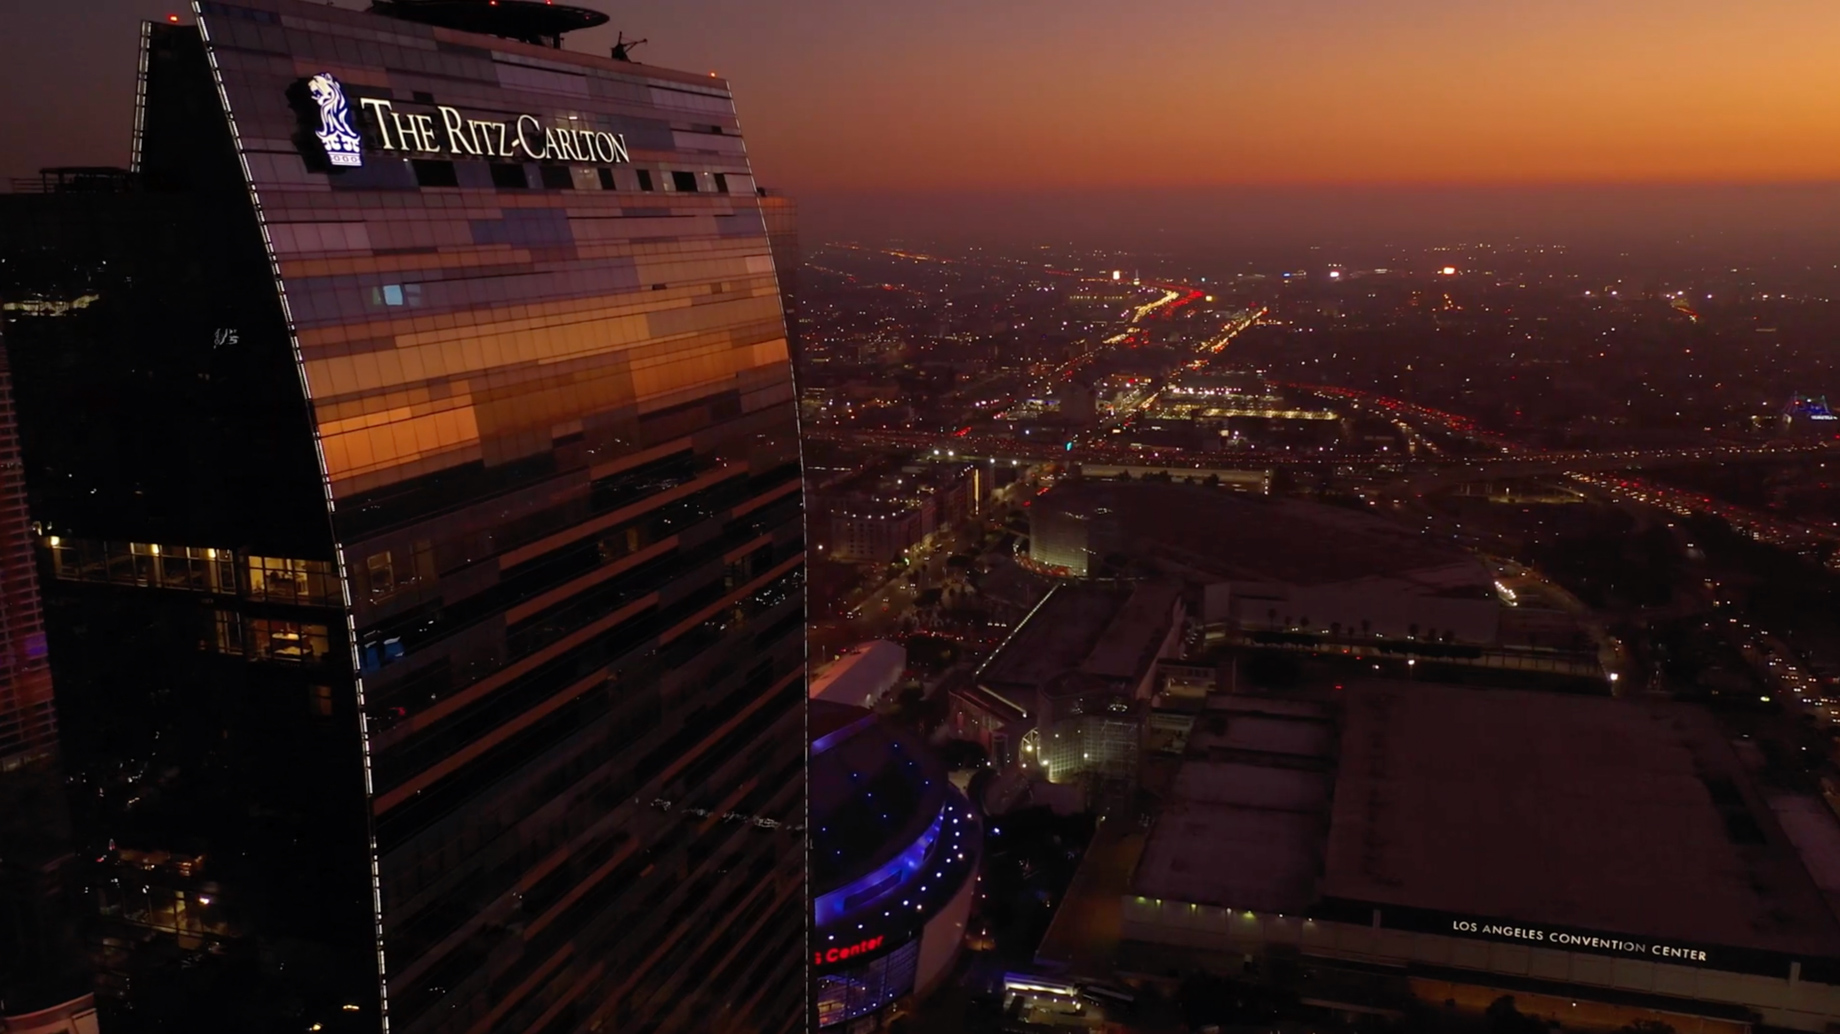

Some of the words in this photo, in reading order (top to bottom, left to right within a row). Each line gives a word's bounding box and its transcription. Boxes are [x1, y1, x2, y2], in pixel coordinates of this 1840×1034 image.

[361, 97, 440, 152] THE
[439, 105, 630, 163] RITZ-CARLTON
[826, 935, 884, 962] Center
[1453, 920, 1477, 932] LOS
[1482, 924, 1544, 941] ANGELES
[1549, 932, 1646, 952] CONVENTION
[1652, 944, 1706, 961] CENTER
